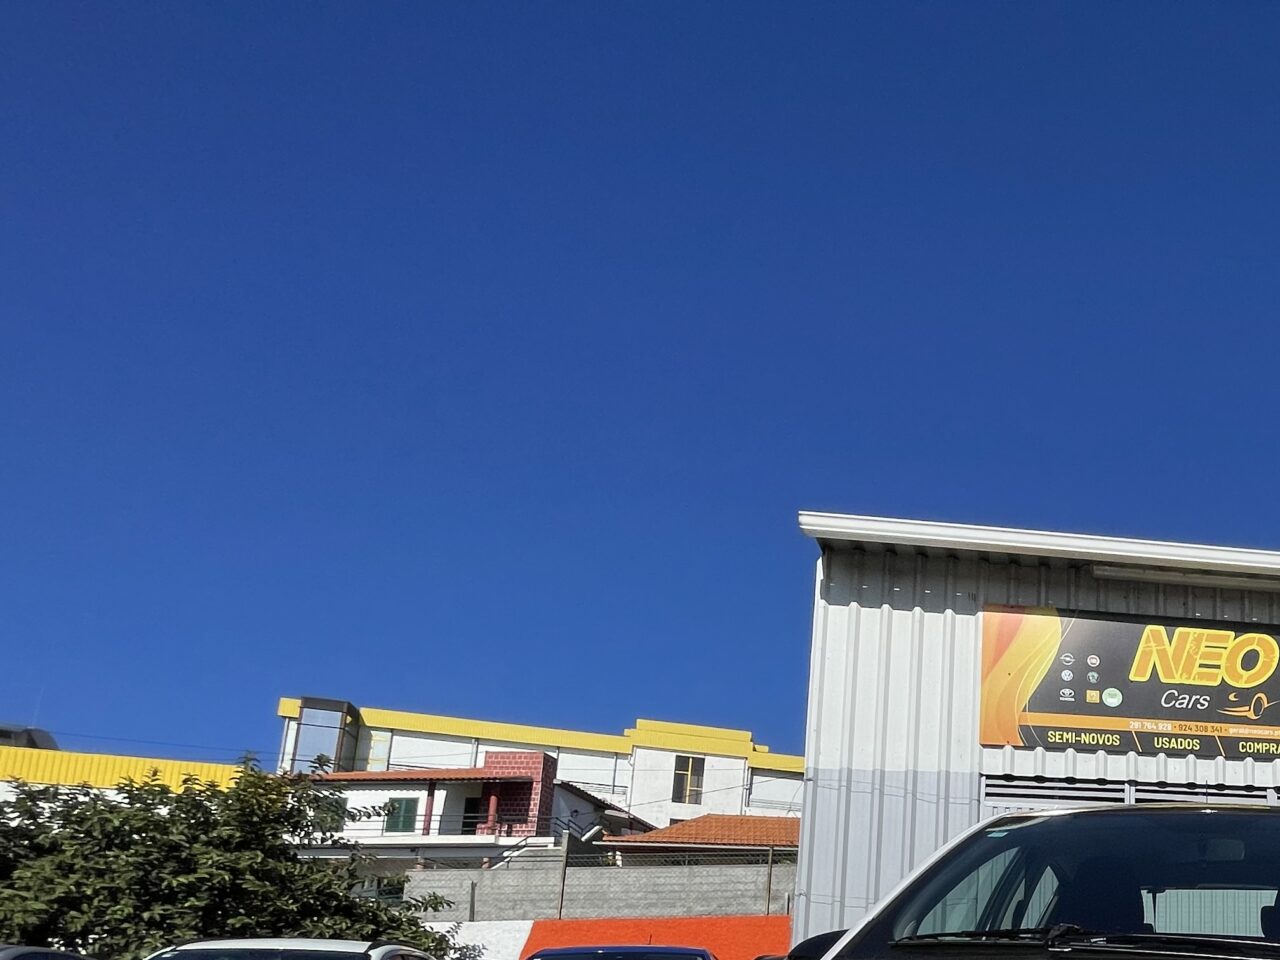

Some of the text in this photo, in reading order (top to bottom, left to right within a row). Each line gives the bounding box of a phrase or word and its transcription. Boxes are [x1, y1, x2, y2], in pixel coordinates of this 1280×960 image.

[1129, 624, 1280, 688] NEO
[1161, 690, 1210, 709] Cars
[1047, 730, 1120, 746] SEMI-NOVOS
[1154, 736, 1200, 750] USADOS
